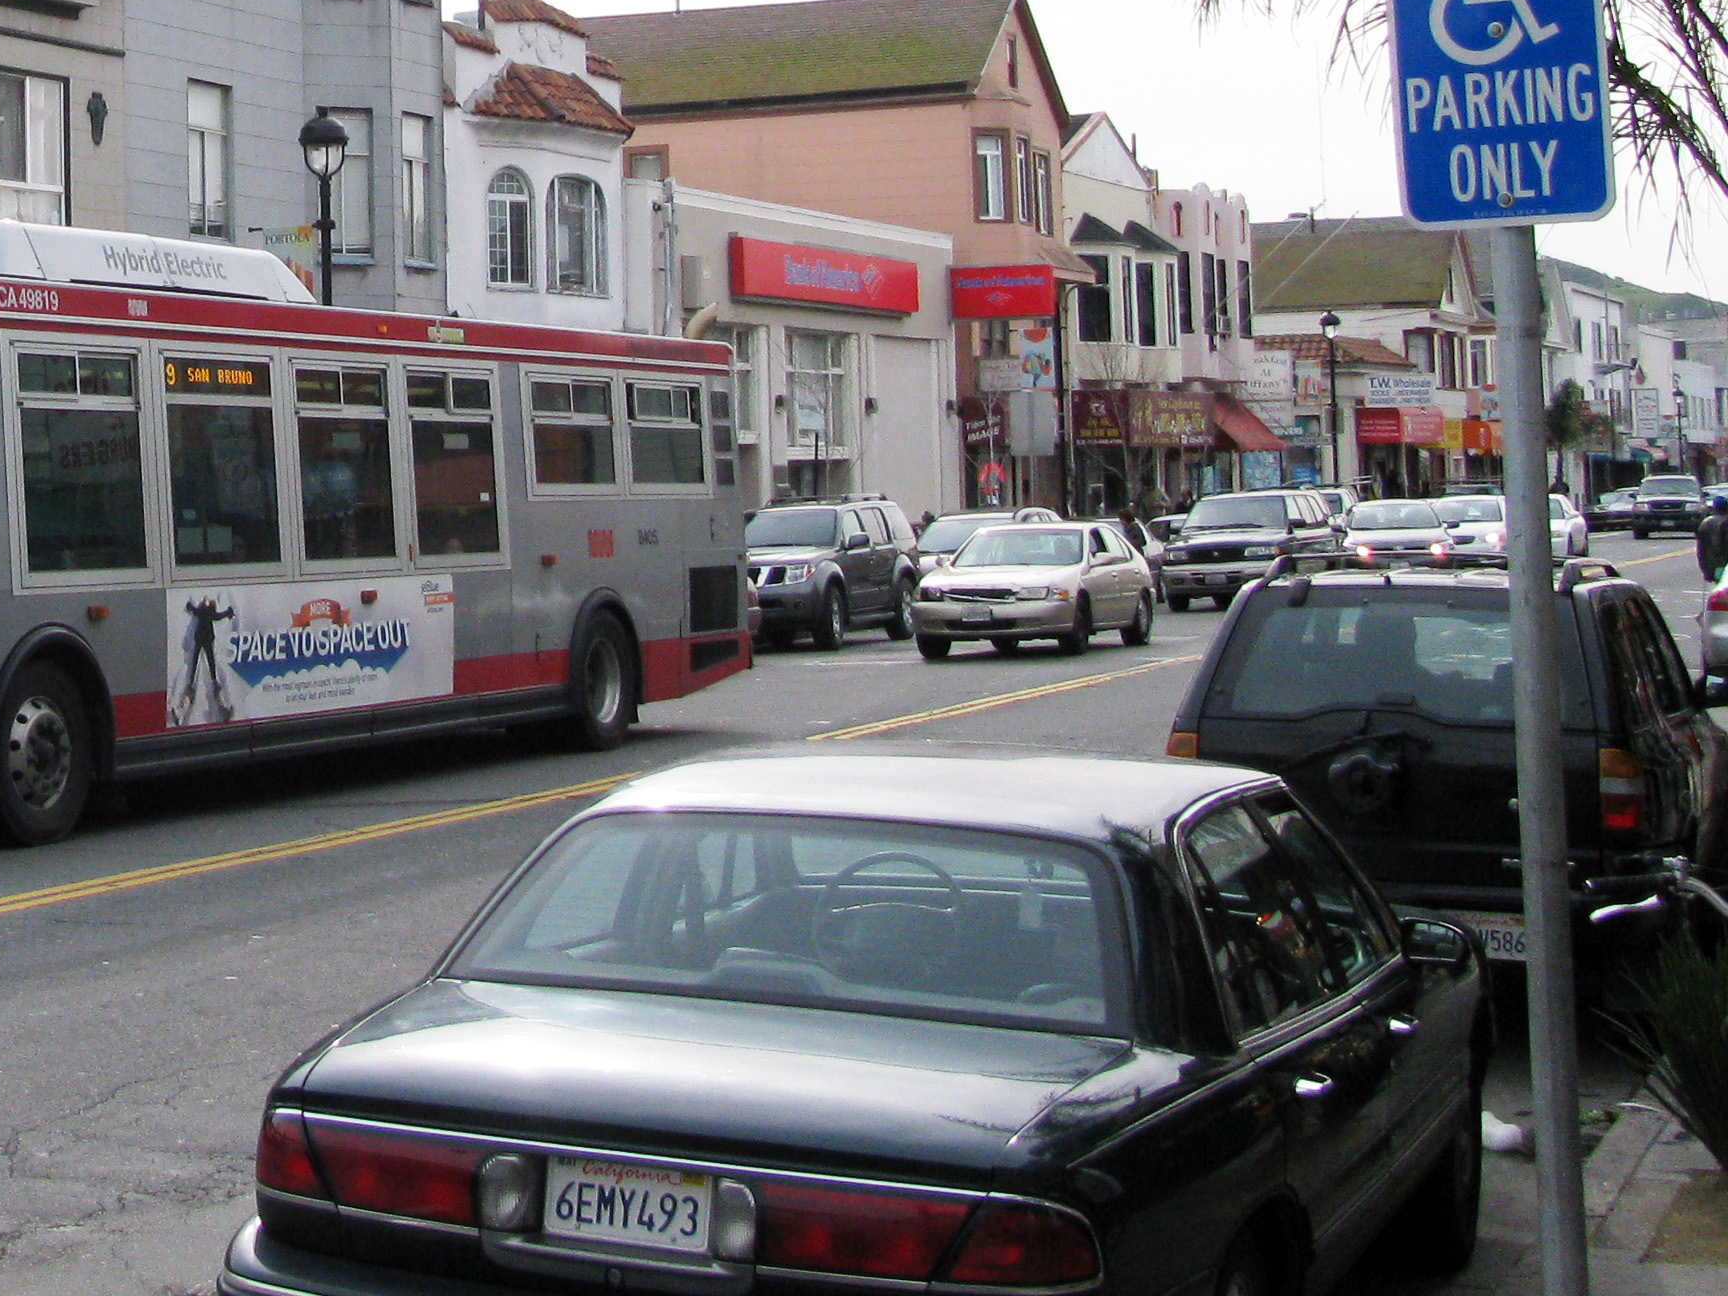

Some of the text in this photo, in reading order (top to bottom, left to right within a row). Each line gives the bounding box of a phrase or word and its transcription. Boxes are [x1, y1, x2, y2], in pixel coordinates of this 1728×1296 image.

[1405, 62, 1594, 134] PARKING
[1448, 139, 1559, 203] ONLY
[101, 244, 228, 281] Hybrid Electric
[18, 288, 60, 312] 49819
[166, 364, 254, 385] 9 SAN BRUNO
[309, 602, 332, 616] MORE
[227, 618, 410, 664] SPACE TO SPACE OUT
[581, 1158, 681, 1185] California
[554, 1181, 699, 1237] 6EMY493
